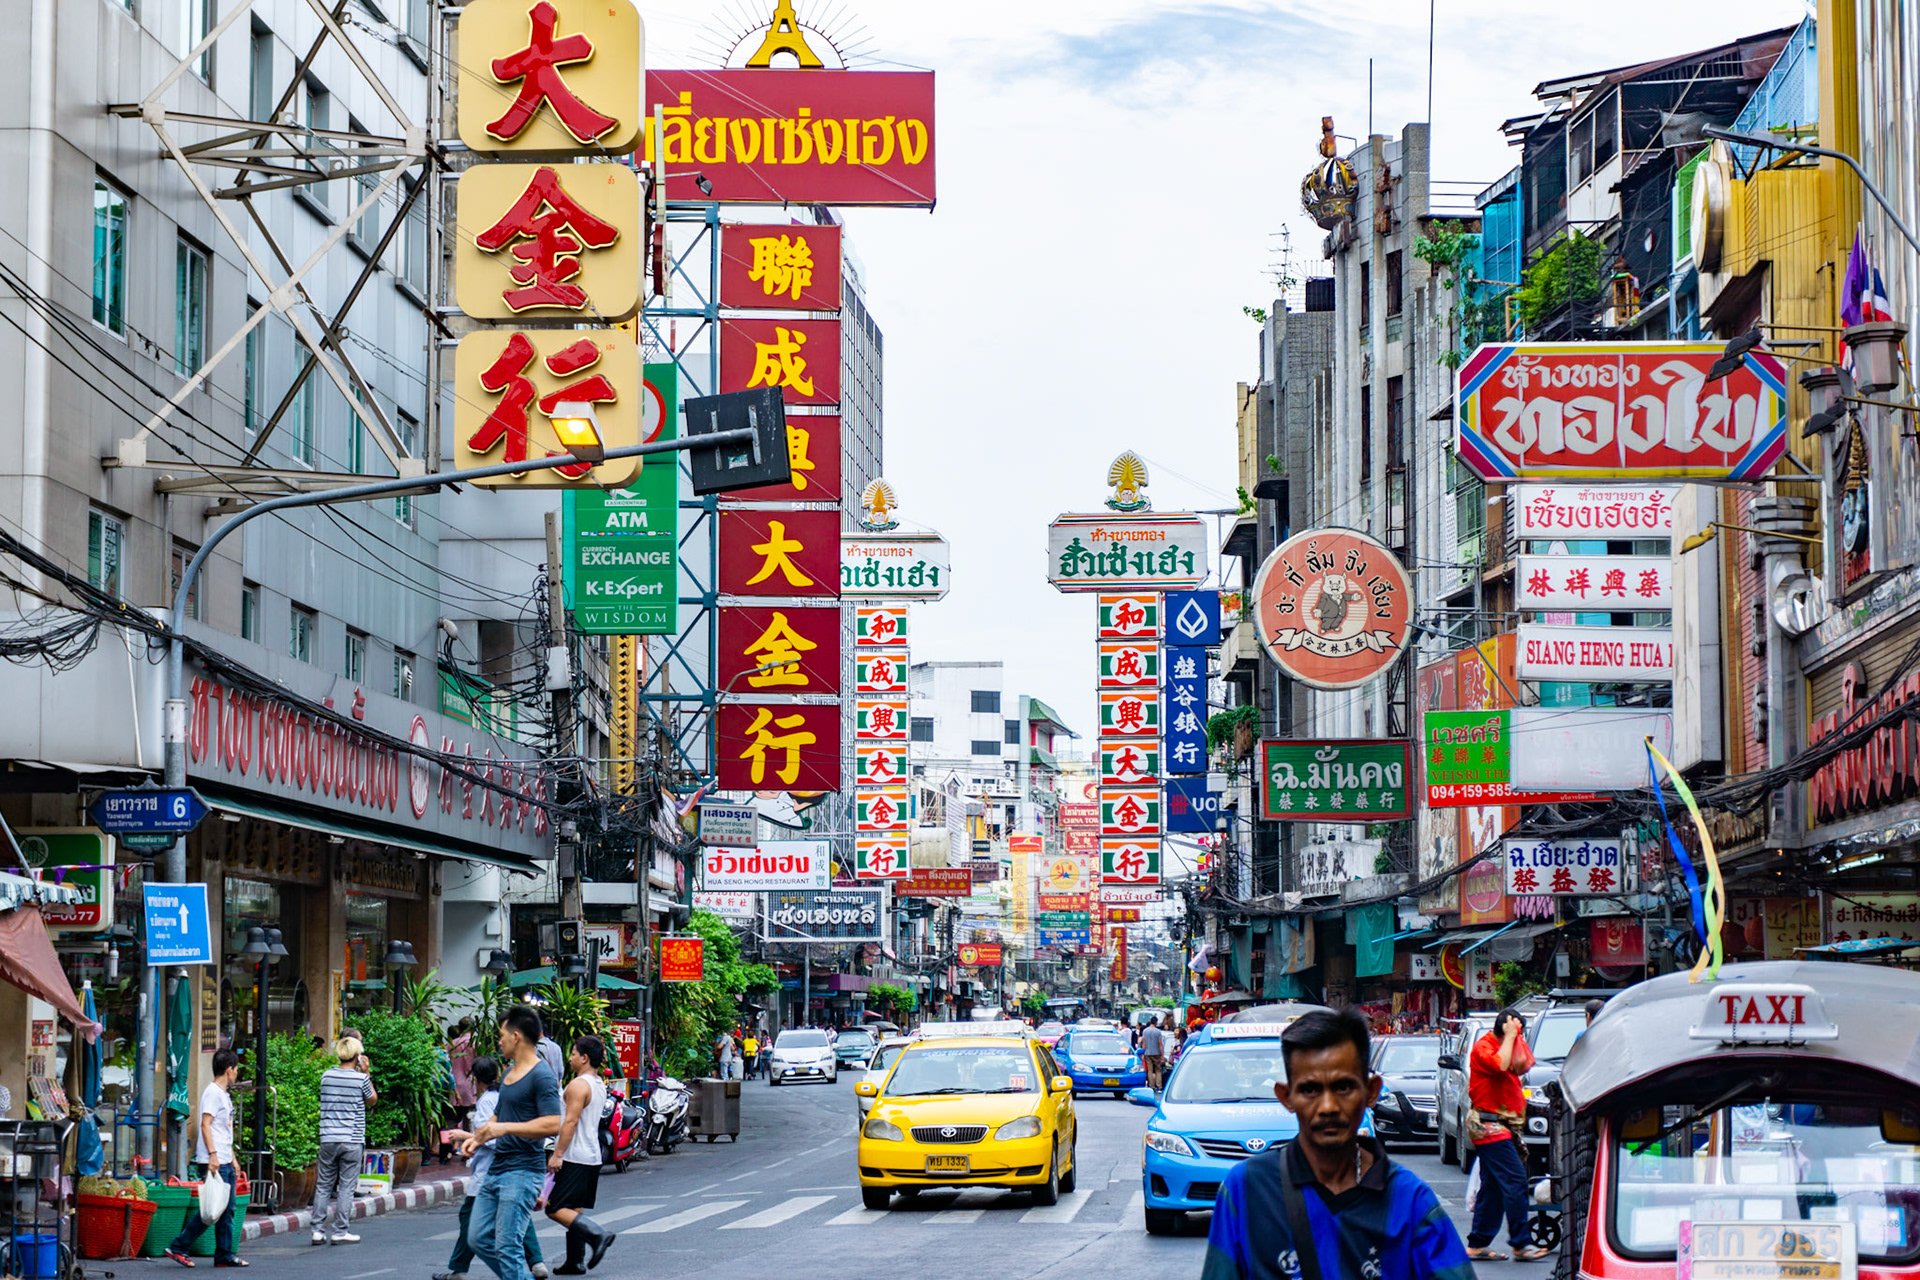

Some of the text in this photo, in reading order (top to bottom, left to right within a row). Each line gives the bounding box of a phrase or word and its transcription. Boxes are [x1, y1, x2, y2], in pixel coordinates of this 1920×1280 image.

[606, 512, 648, 528] ATM
[1090, 528, 1165, 542] ห้างขายทอง
[582, 552, 671, 565] EXCHANGE
[846, 544, 913, 556] ห้างขายทอง
[586, 576, 664, 600] K-Expert
[1526, 568, 1672, 599] 林祥興藥
[585, 612, 667, 623] WISDOM
[1526, 640, 1664, 667] SIANG HENG HUA
[1432, 716, 1501, 743] เวชศรี
[1431, 747, 1511, 766] 華聯藥
[1431, 770, 1480, 782] VEJSRI
[105, 797, 186, 818] เยาวราช 6
[106, 812, 133, 820] Yaowarat
[704, 809, 752, 822] แสงอรุณ
[1511, 866, 1617, 893] 蔡益發
[1718, 995, 1806, 1024] TAXI
[946, 1157, 967, 1167] 1332
[1757, 1226, 1839, 1257] 2955
